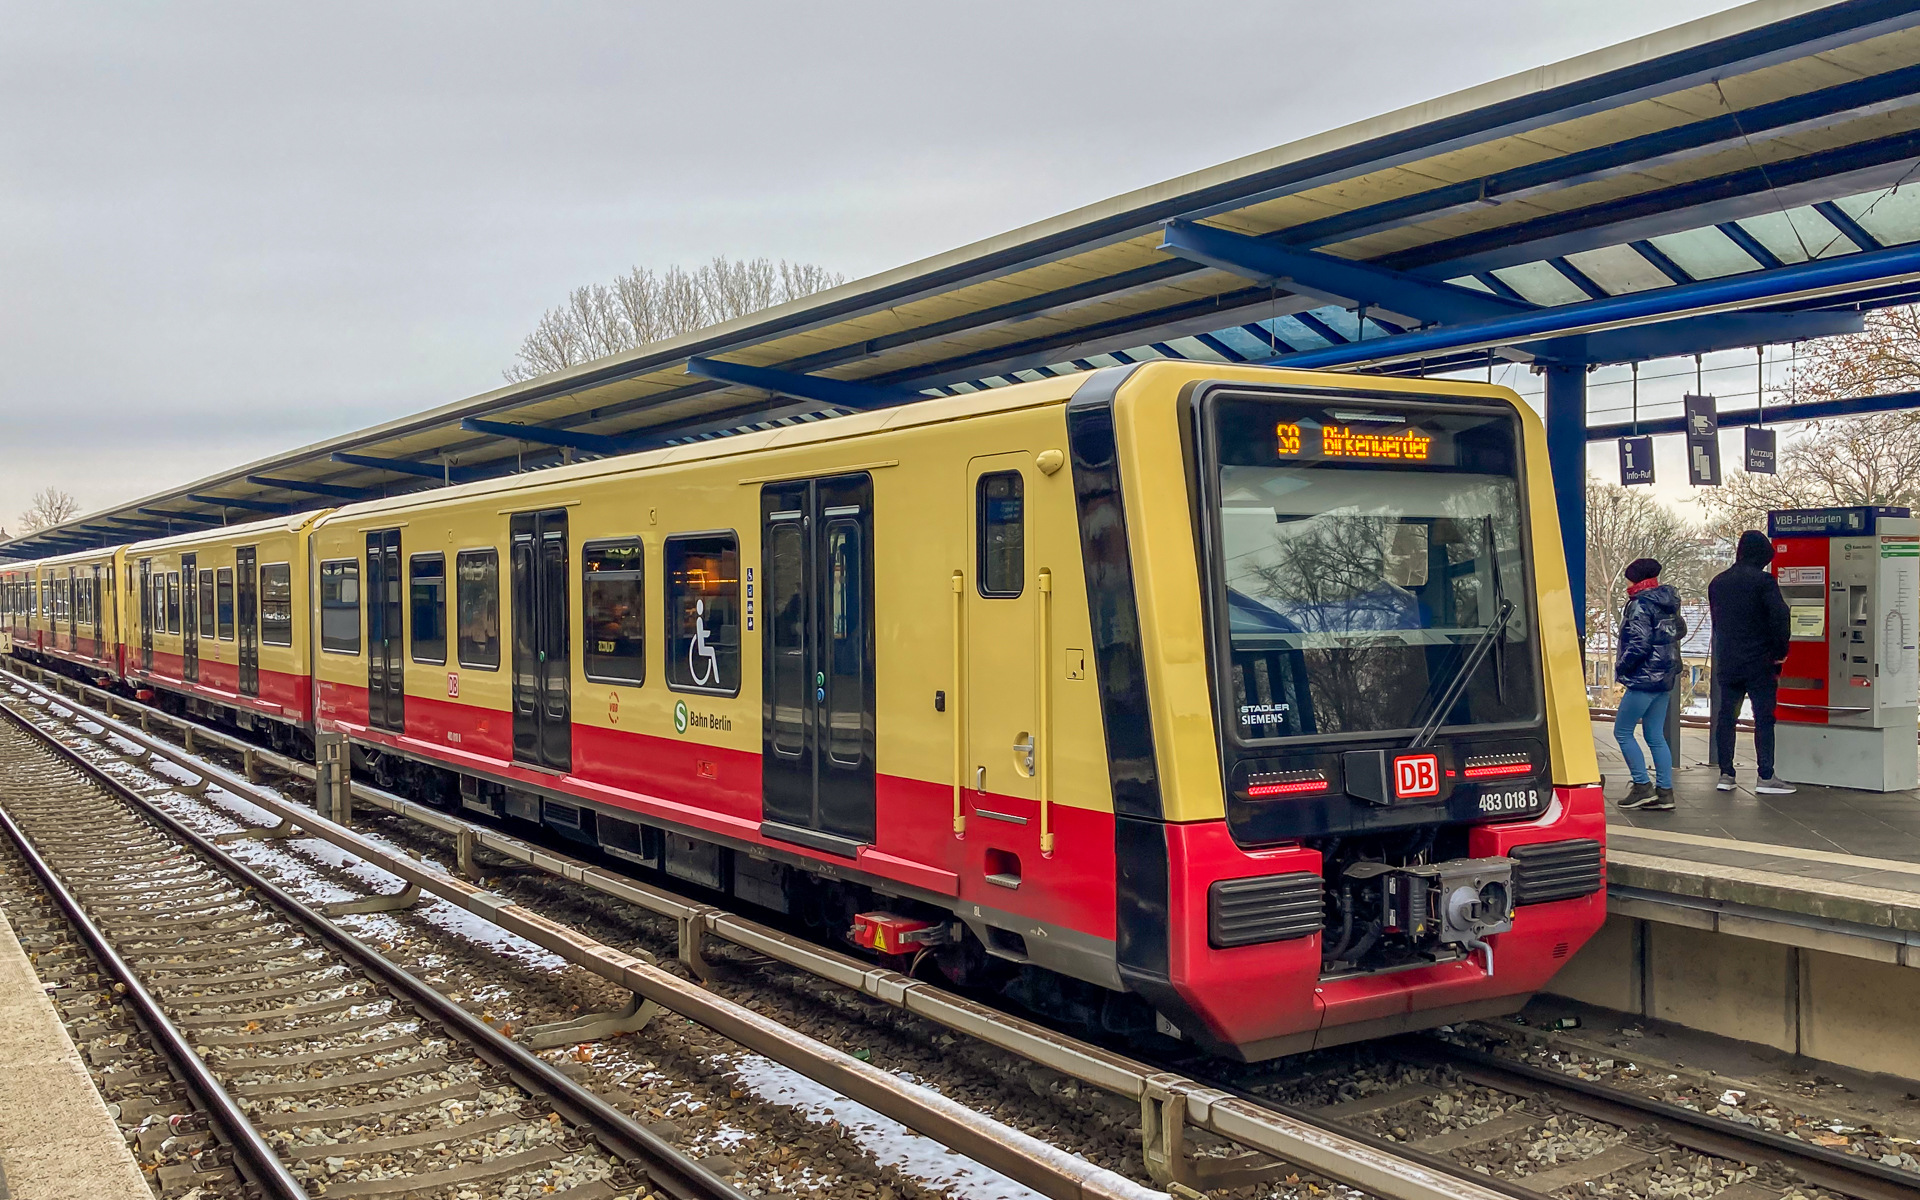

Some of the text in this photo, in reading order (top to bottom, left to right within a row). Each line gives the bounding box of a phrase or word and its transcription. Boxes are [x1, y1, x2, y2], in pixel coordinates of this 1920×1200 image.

[1323, 426, 1431, 459] Birkenwerder
[1750, 447, 1774, 460] Kurzzug
[1750, 458, 1765, 468] Ende
[1626, 469, 1652, 480] Info-Ruf
[1775, 514, 1842, 526] VBB-Fahrkarten
[449, 676, 458, 694] DB
[1241, 703, 1290, 713] STADLER
[676, 702, 732, 732] S Bahn Berlin
[1241, 713, 1284, 725] SIEMENS
[1400, 761, 1434, 791] DB
[1478, 789, 1538, 812] 483 018 B
